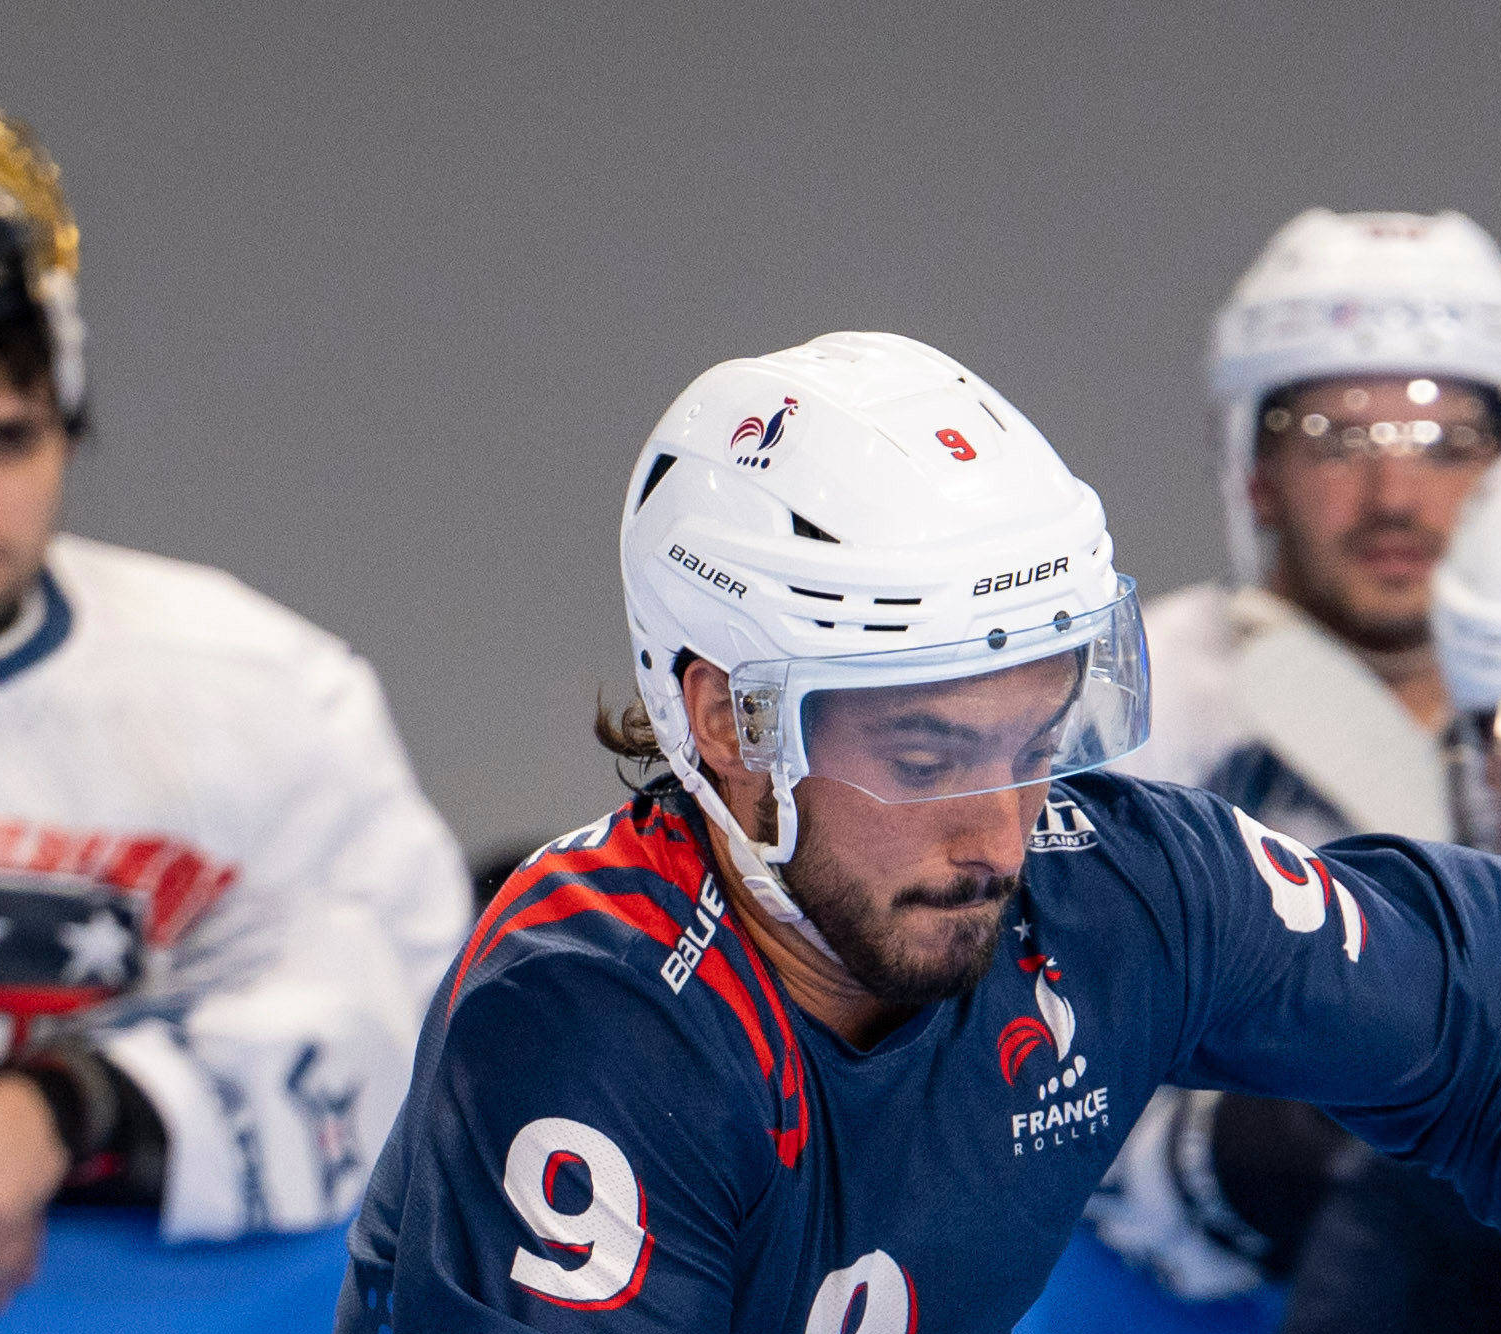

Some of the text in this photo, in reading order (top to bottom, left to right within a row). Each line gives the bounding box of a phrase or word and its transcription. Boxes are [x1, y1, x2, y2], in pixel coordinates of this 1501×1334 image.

[936, 428, 977, 461] 9
[668, 543, 748, 600] BAUER
[973, 556, 1070, 598] BAUER
[660, 871, 725, 996] BAUE
[1011, 1086, 1109, 1139] FRANCE
[1013, 1115, 1110, 1157] ROLLER
[504, 1116, 655, 1312] 9
